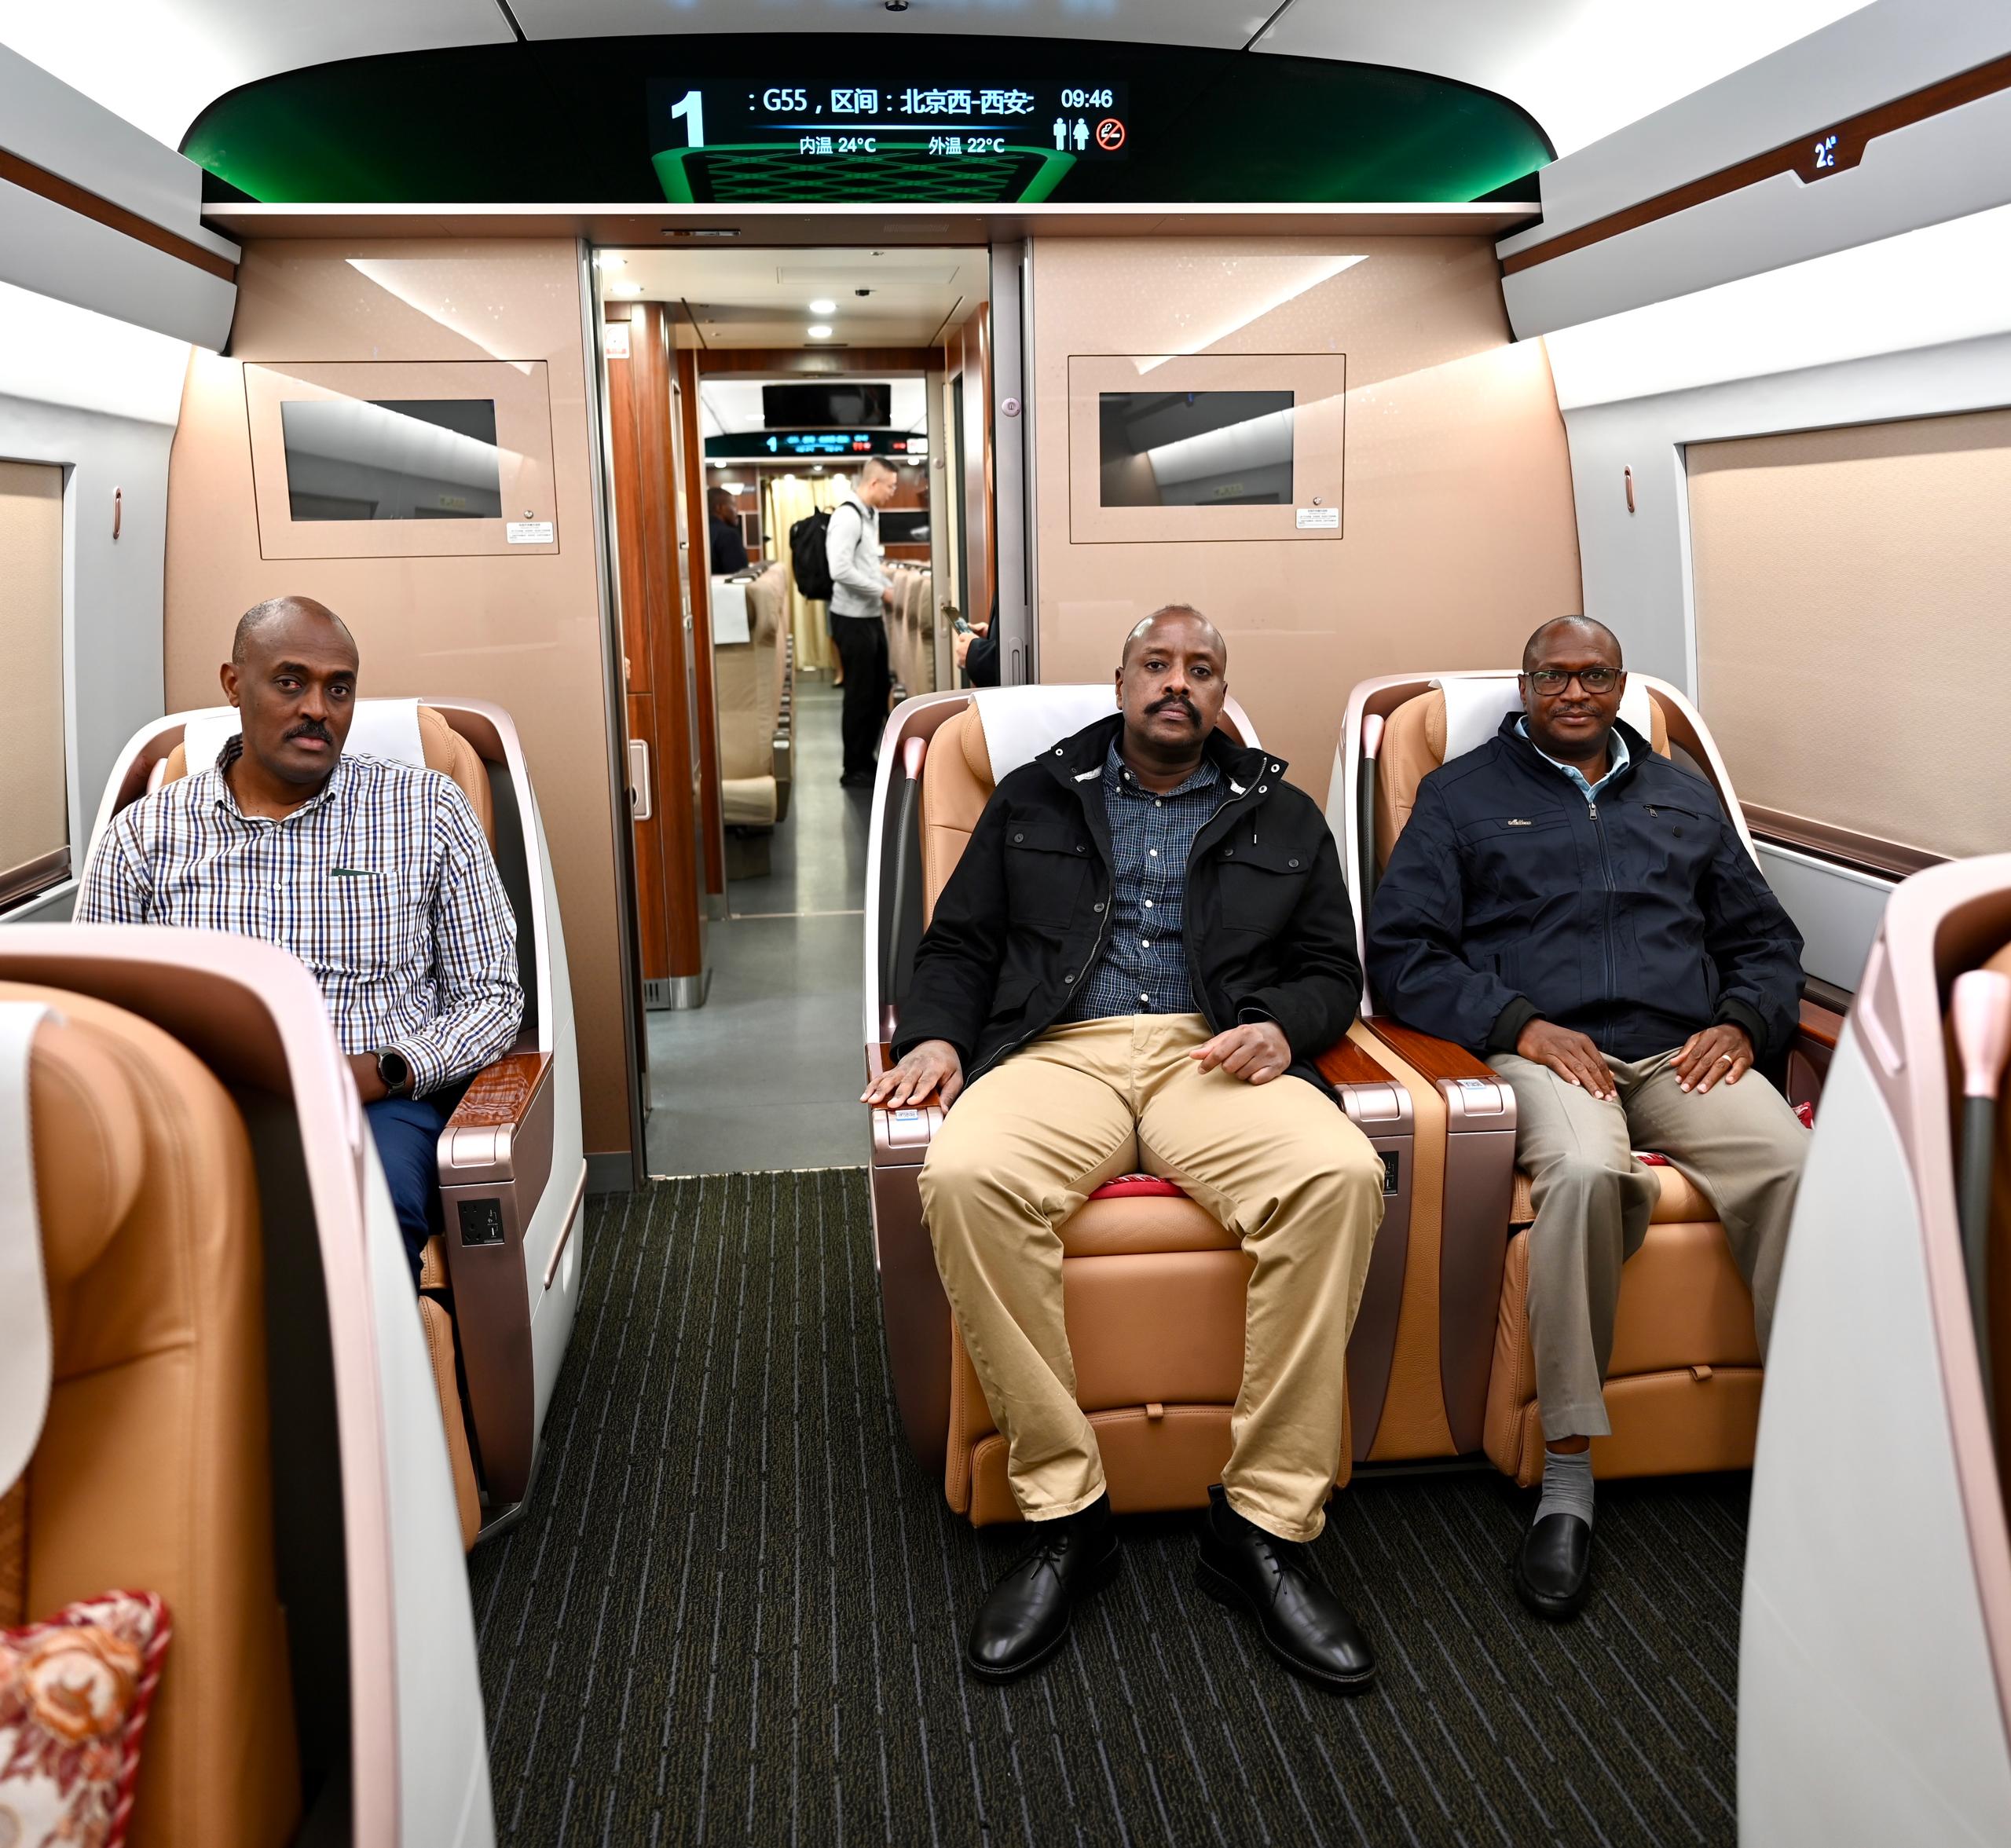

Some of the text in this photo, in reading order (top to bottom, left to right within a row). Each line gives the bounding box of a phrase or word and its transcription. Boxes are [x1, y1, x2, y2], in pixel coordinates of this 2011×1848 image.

[1060, 89, 1113, 108] 09:46
[671, 90, 705, 148] 1
[800, 135, 833, 155] 内温
[928, 136, 962, 156] 外温
[766, 436, 778, 452] 1
